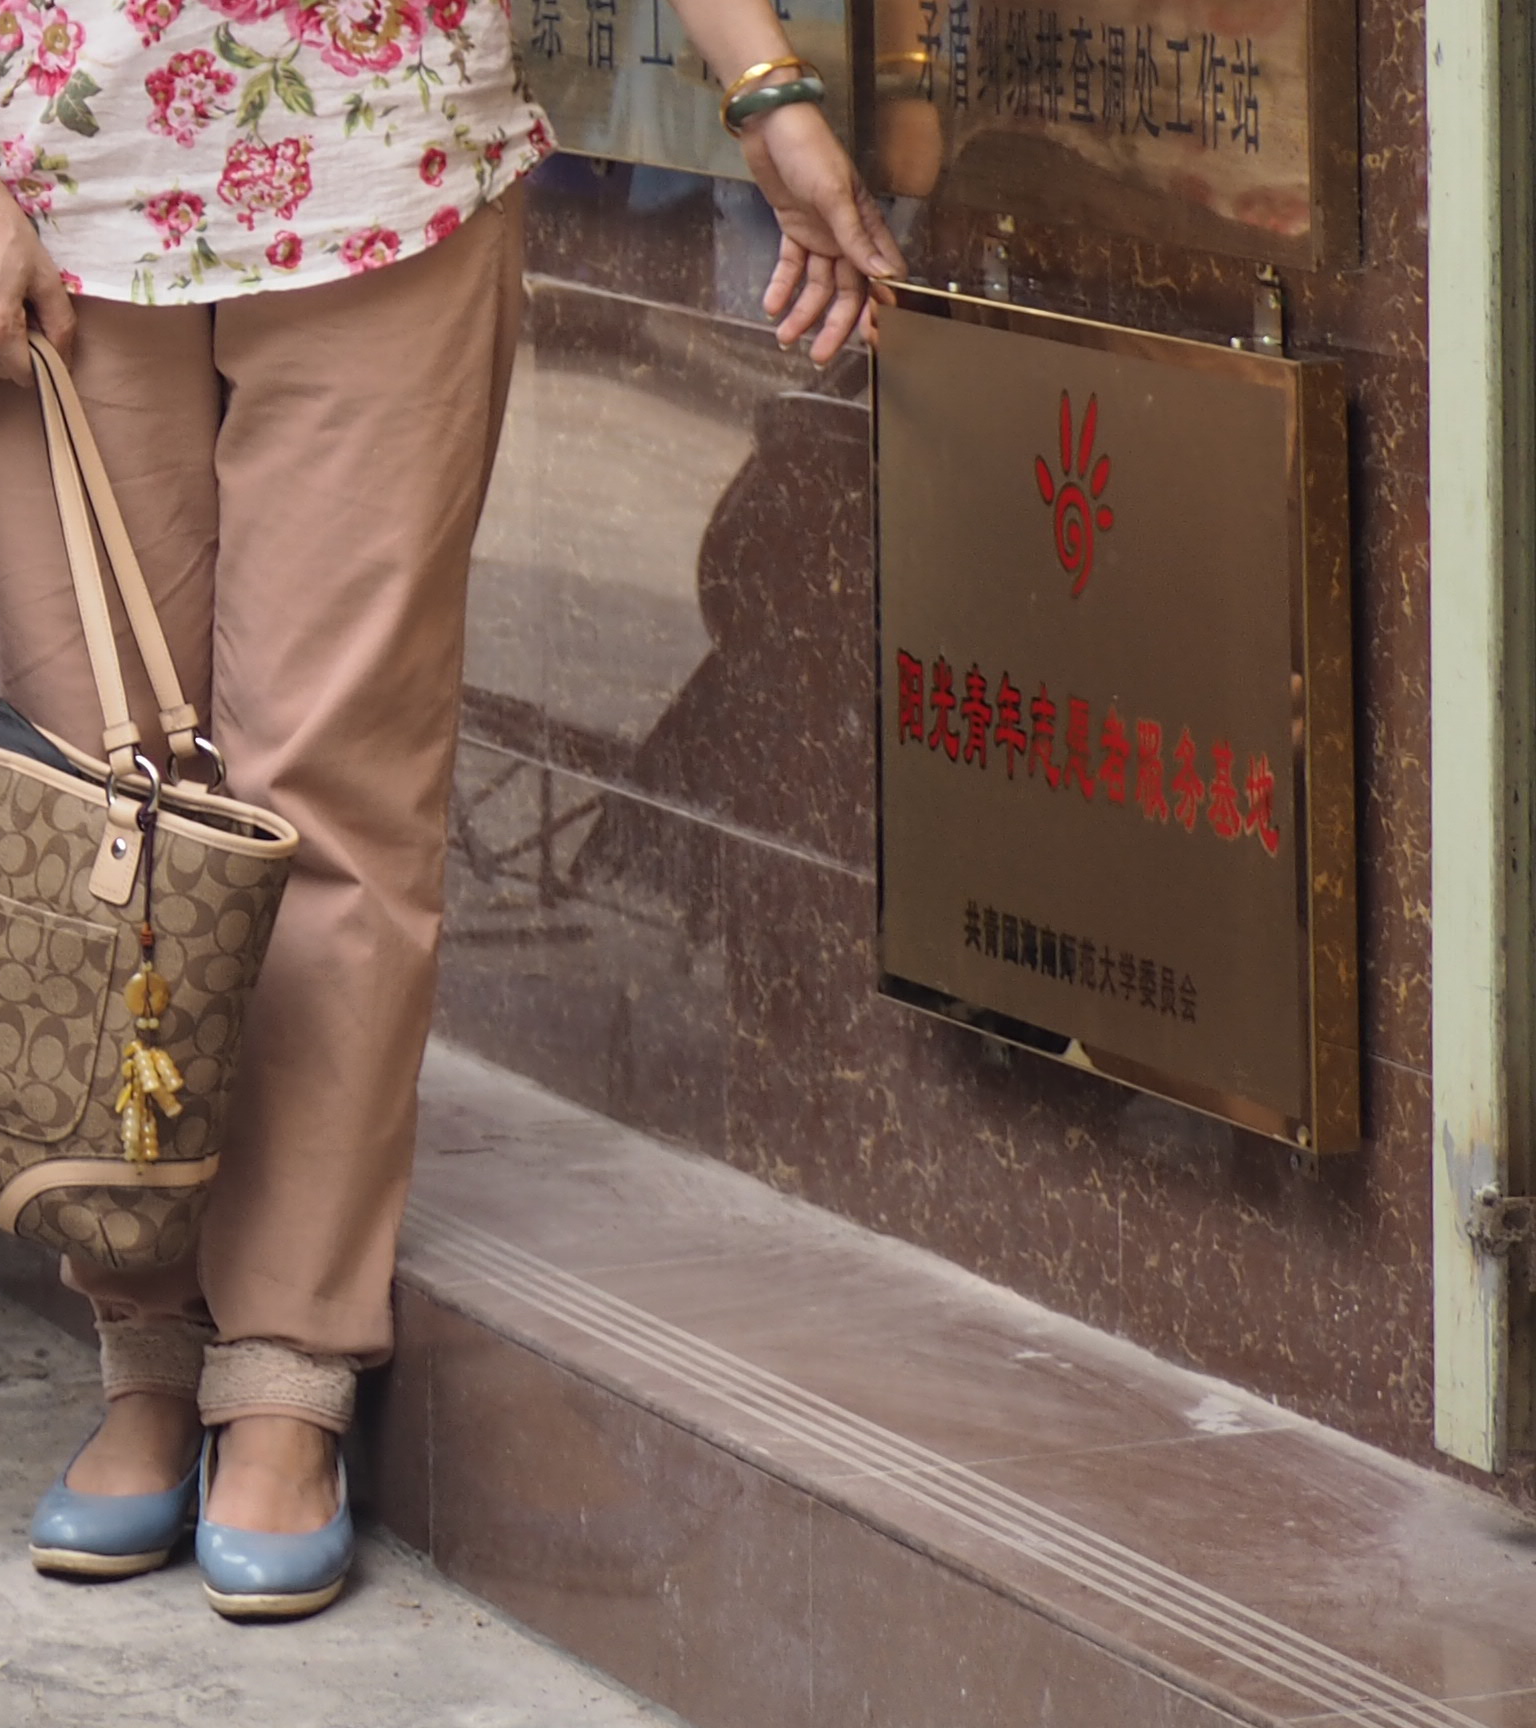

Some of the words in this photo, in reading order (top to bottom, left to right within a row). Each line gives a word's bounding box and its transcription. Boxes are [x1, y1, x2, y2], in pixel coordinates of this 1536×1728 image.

[915, 0, 1261, 154] 矛盾纠纷排查调处工作站
[896, 647, 1280, 859] 阳光青年志愿者服务基地
[963, 896, 1199, 1025] 共青团海南师范大学委员会
